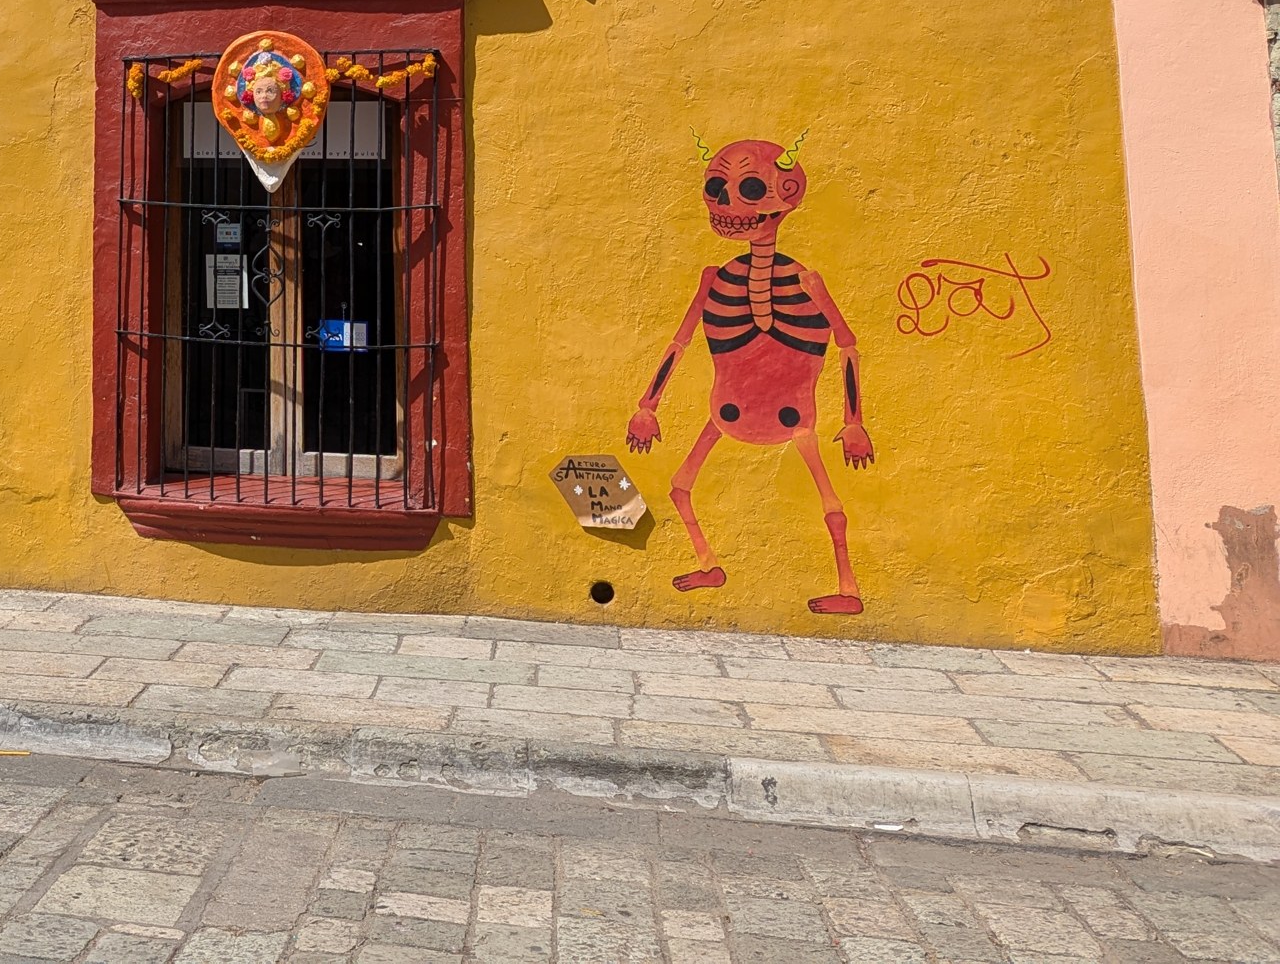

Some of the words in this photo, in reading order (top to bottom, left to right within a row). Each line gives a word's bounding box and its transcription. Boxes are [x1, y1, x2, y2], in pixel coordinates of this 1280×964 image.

[565, 459, 606, 476] ARTURO
[554, 469, 615, 483] SANTIAGO
[588, 486, 609, 498] LA
